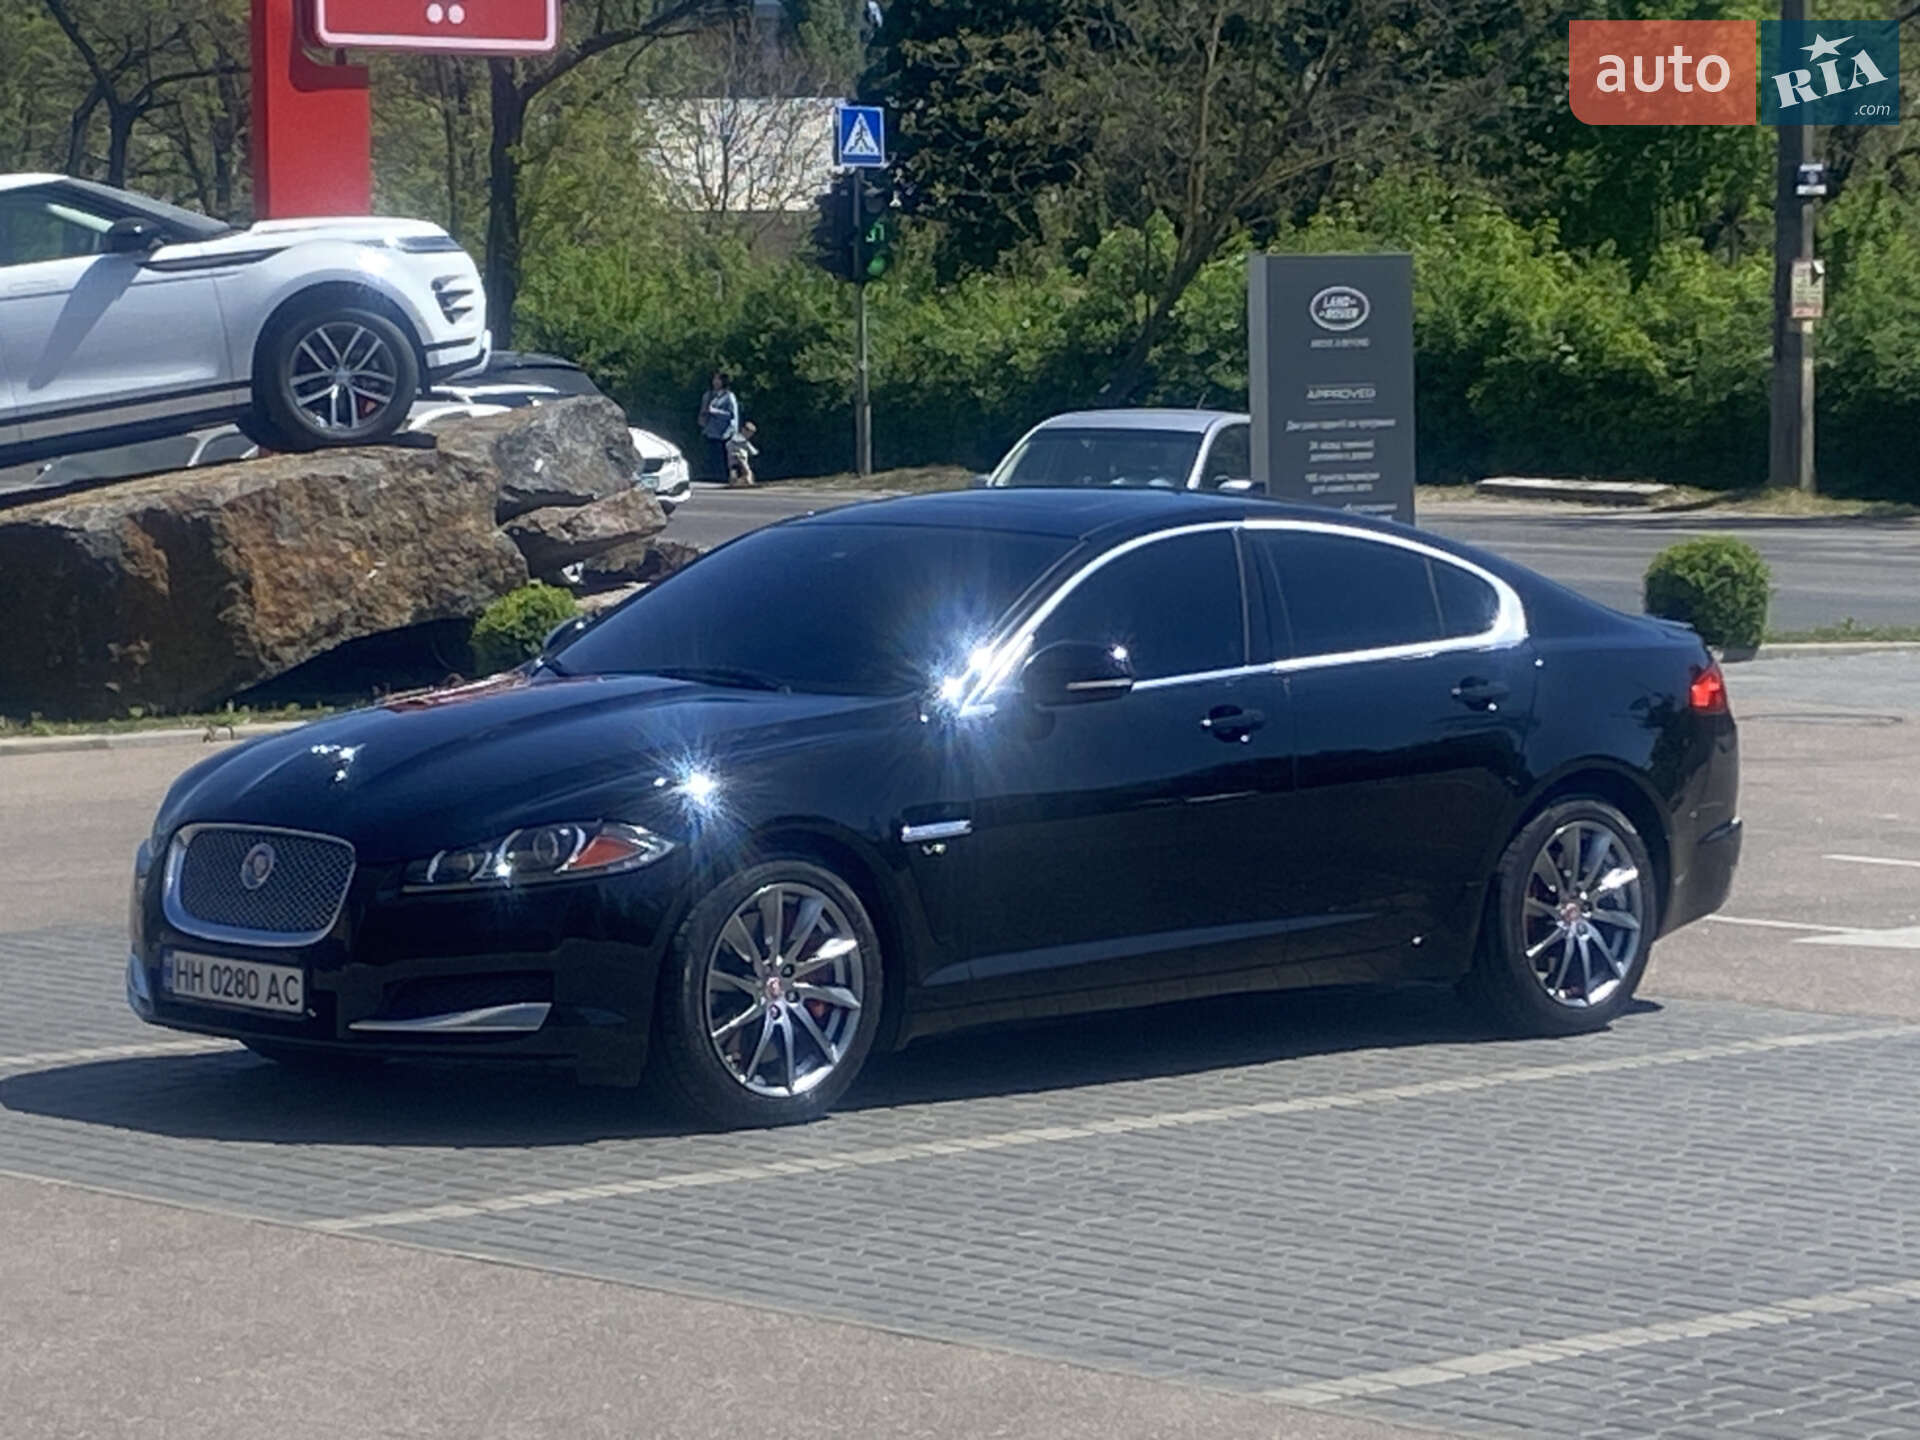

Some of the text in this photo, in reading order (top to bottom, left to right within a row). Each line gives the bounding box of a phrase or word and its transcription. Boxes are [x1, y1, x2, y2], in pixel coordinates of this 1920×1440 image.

[175, 957, 300, 1007] HH 0280 AC
